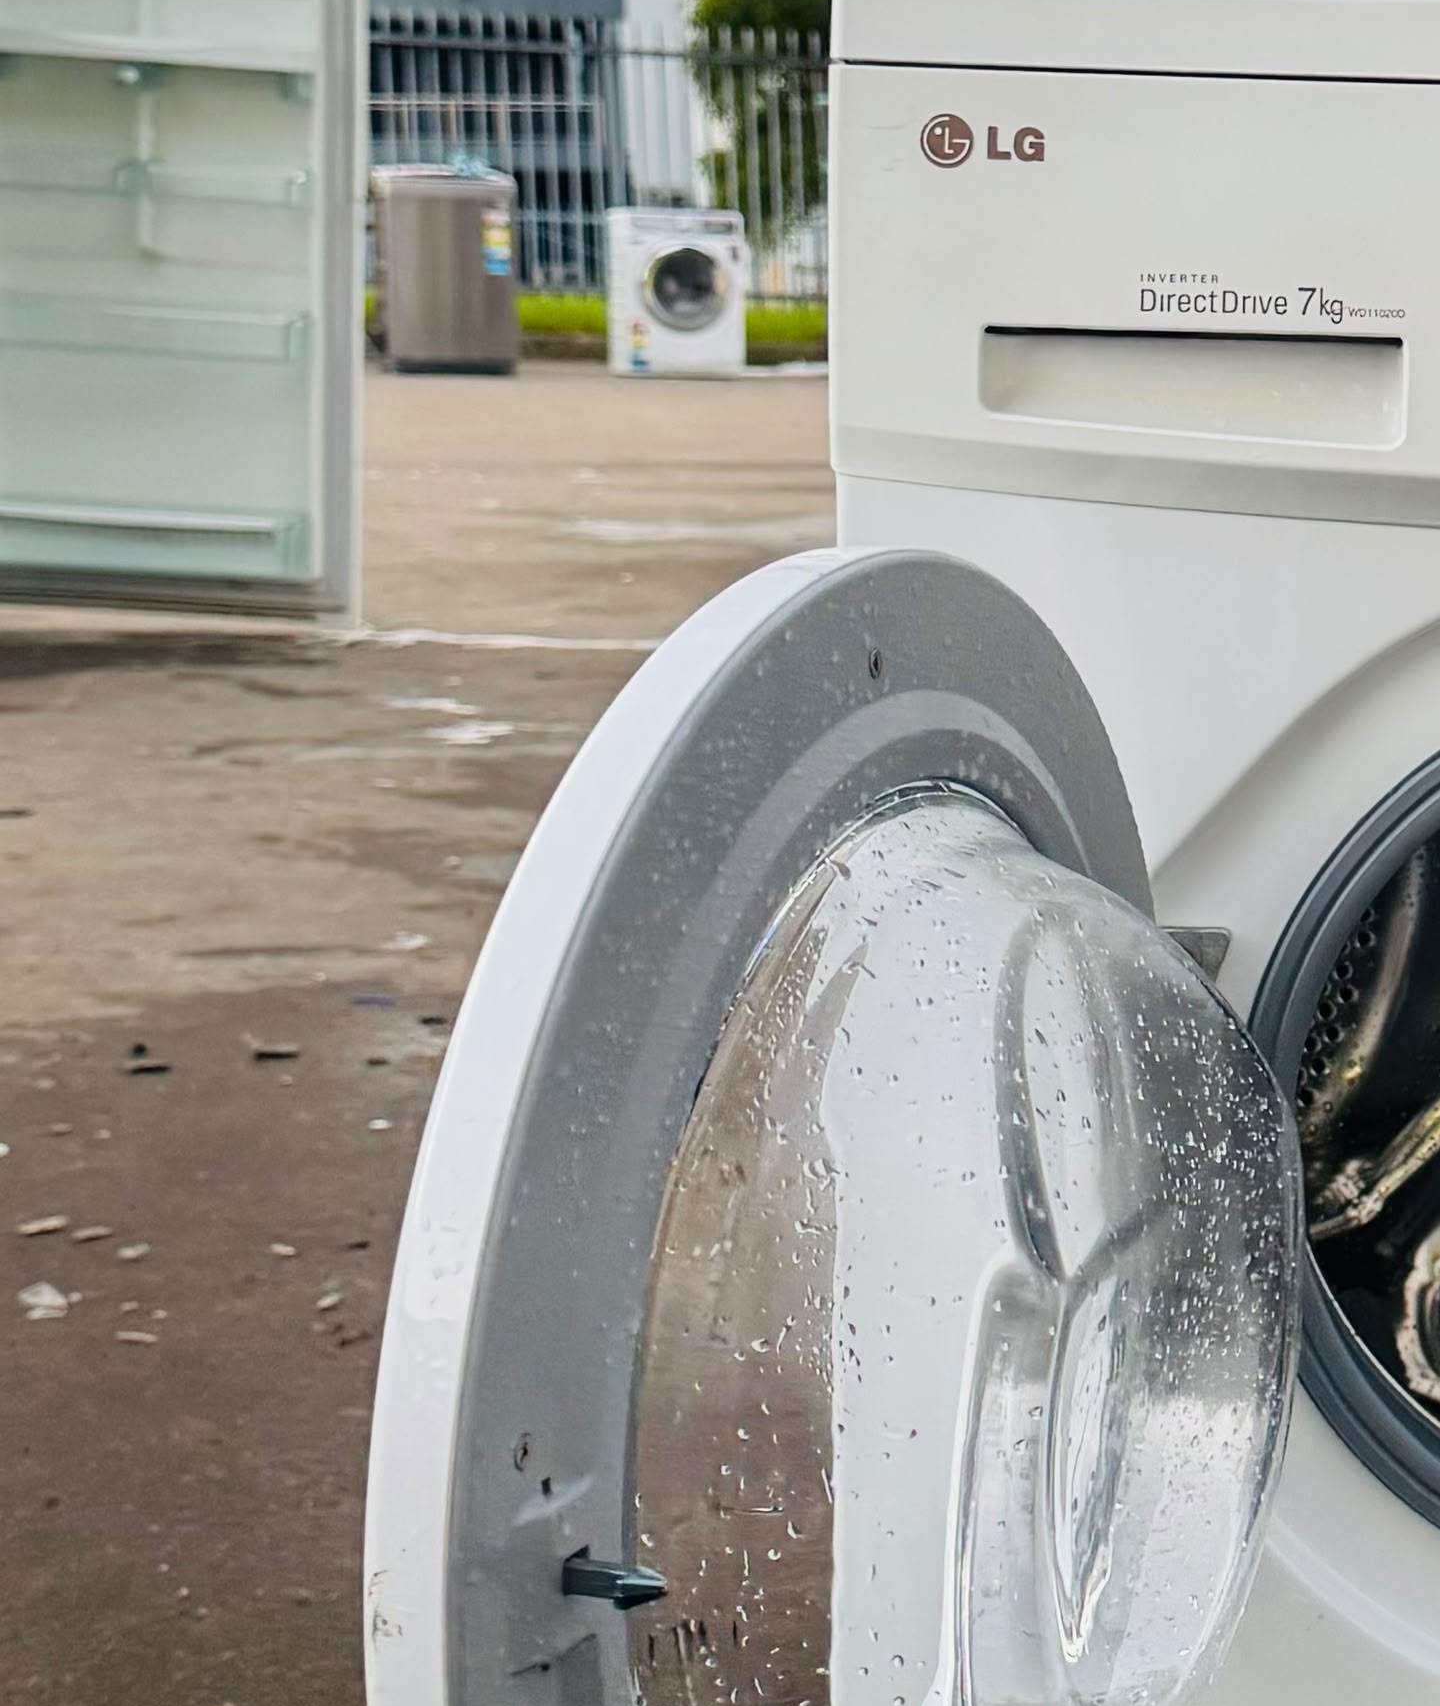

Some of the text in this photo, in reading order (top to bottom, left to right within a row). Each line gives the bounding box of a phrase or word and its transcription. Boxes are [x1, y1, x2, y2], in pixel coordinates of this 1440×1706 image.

[987, 126, 1045, 162] LG
[1140, 274, 1219, 284] INVERTER
[1298, 287, 1343, 324] 7kg
